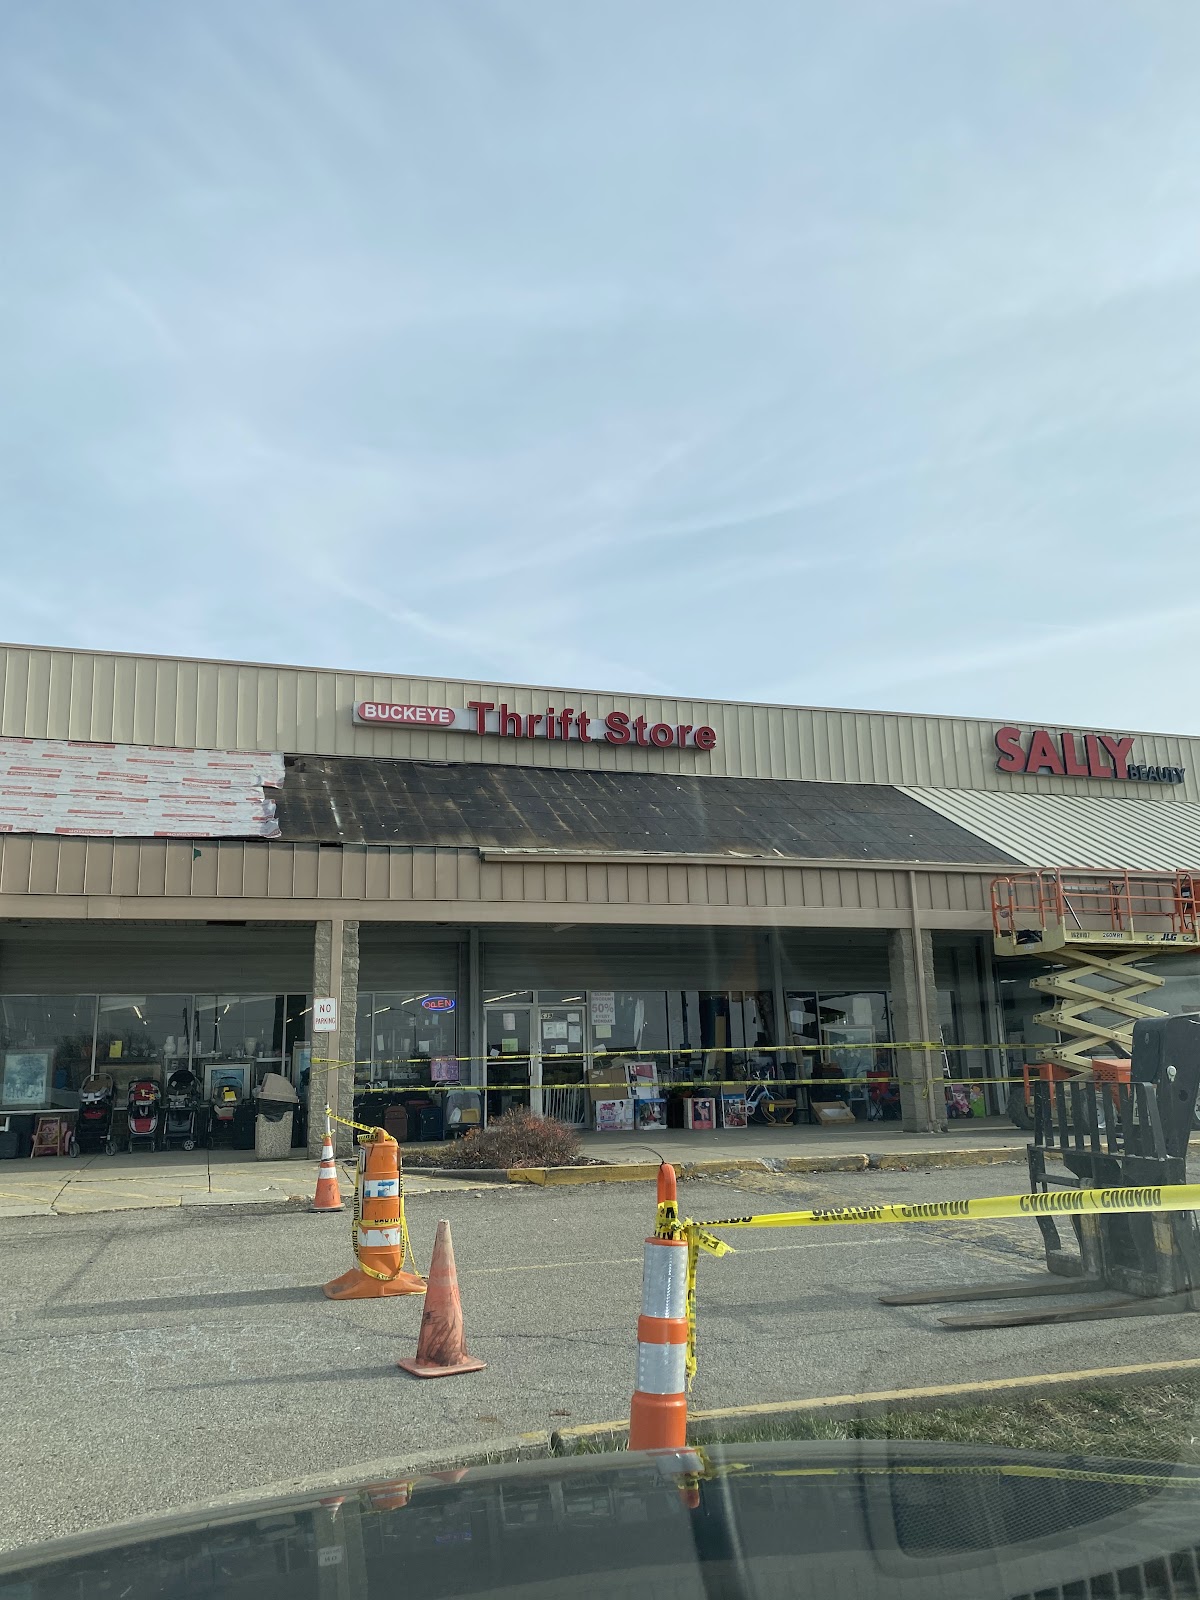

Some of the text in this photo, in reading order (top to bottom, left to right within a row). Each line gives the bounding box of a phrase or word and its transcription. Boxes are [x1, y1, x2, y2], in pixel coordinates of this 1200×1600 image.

[363, 701, 718, 751] BUCKEYE Thrift Store
[995, 726, 1186, 784] SALLY BEAUTY
[1161, 933, 1177, 941] JLG
[319, 1004, 331, 1013] NO
[423, 999, 452, 1009] OPEN
[591, 1003, 614, 1013] 50%
